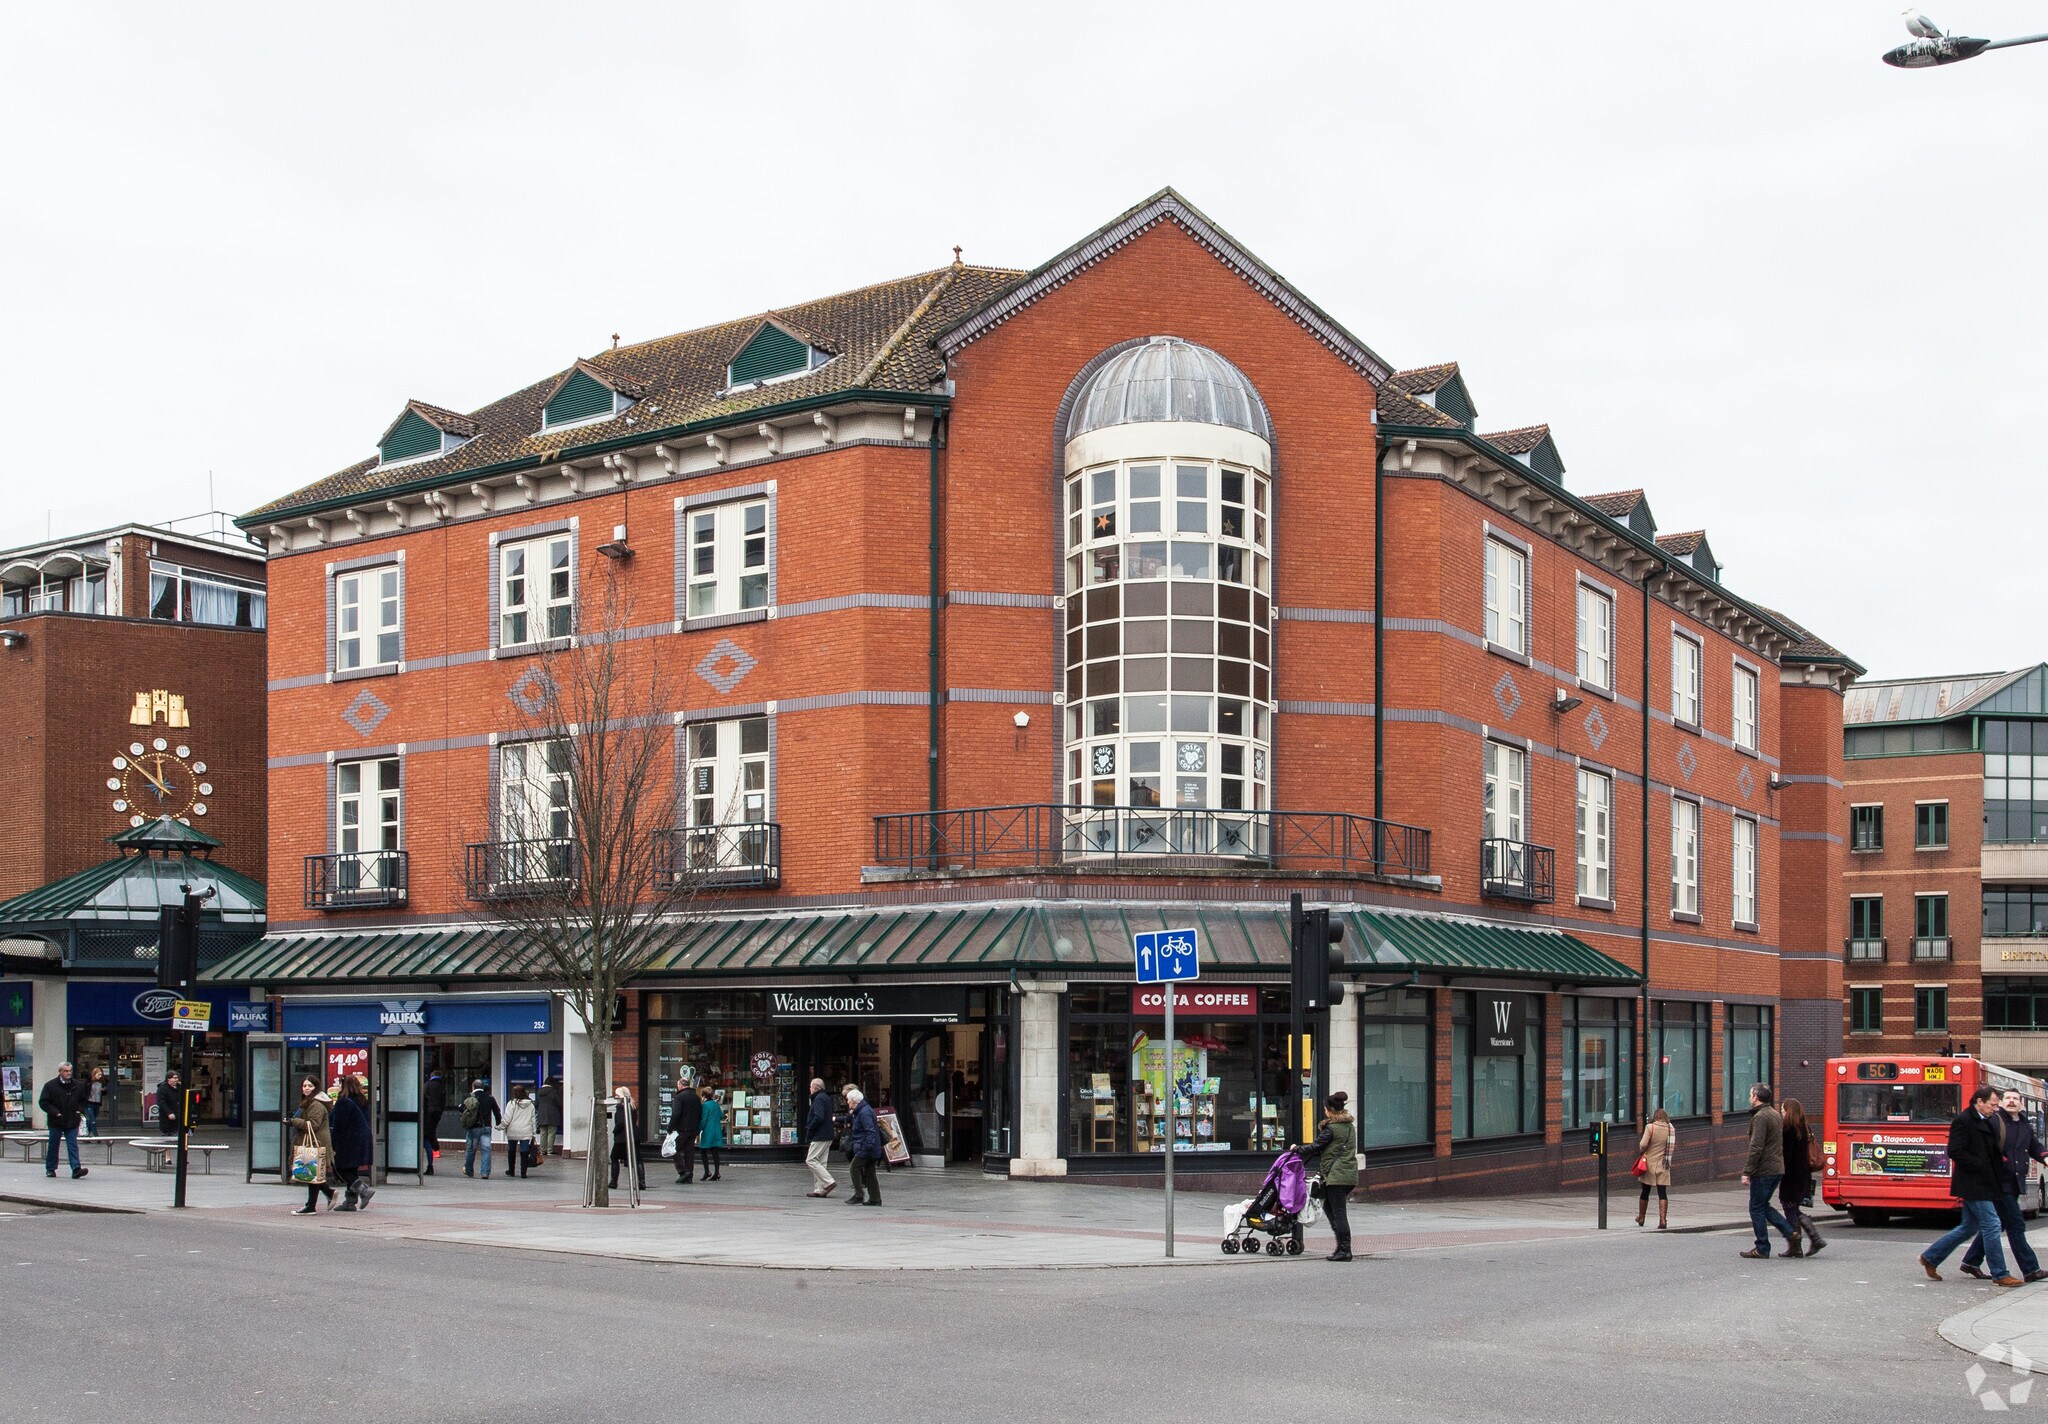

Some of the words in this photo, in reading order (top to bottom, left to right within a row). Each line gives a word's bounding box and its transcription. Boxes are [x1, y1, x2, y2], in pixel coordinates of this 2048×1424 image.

[1095, 747, 1110, 757] COSTA
[1181, 744, 1201, 753] COSTA
[1094, 762, 1113, 773] COFFEE
[1180, 759, 1203, 770] COFFEE
[773, 992, 874, 1011] Waterstone's
[1141, 994, 1190, 1006] COTA
[1194, 994, 1249, 1006] COFFEE
[231, 1013, 267, 1021] HALIFAX
[380, 1012, 425, 1024] HALIFAX
[1492, 1001, 1512, 1034] W
[533, 1021, 545, 1029] 252
[754, 1053, 773, 1061] COSTA
[329, 1053, 358, 1075] £1.49
[753, 1067, 775, 1077] COFFEE
[1869, 1064, 1886, 1078] 5C
[1899, 1067, 1920, 1075] 34860
[1882, 1135, 1925, 1145] Stagecoach
